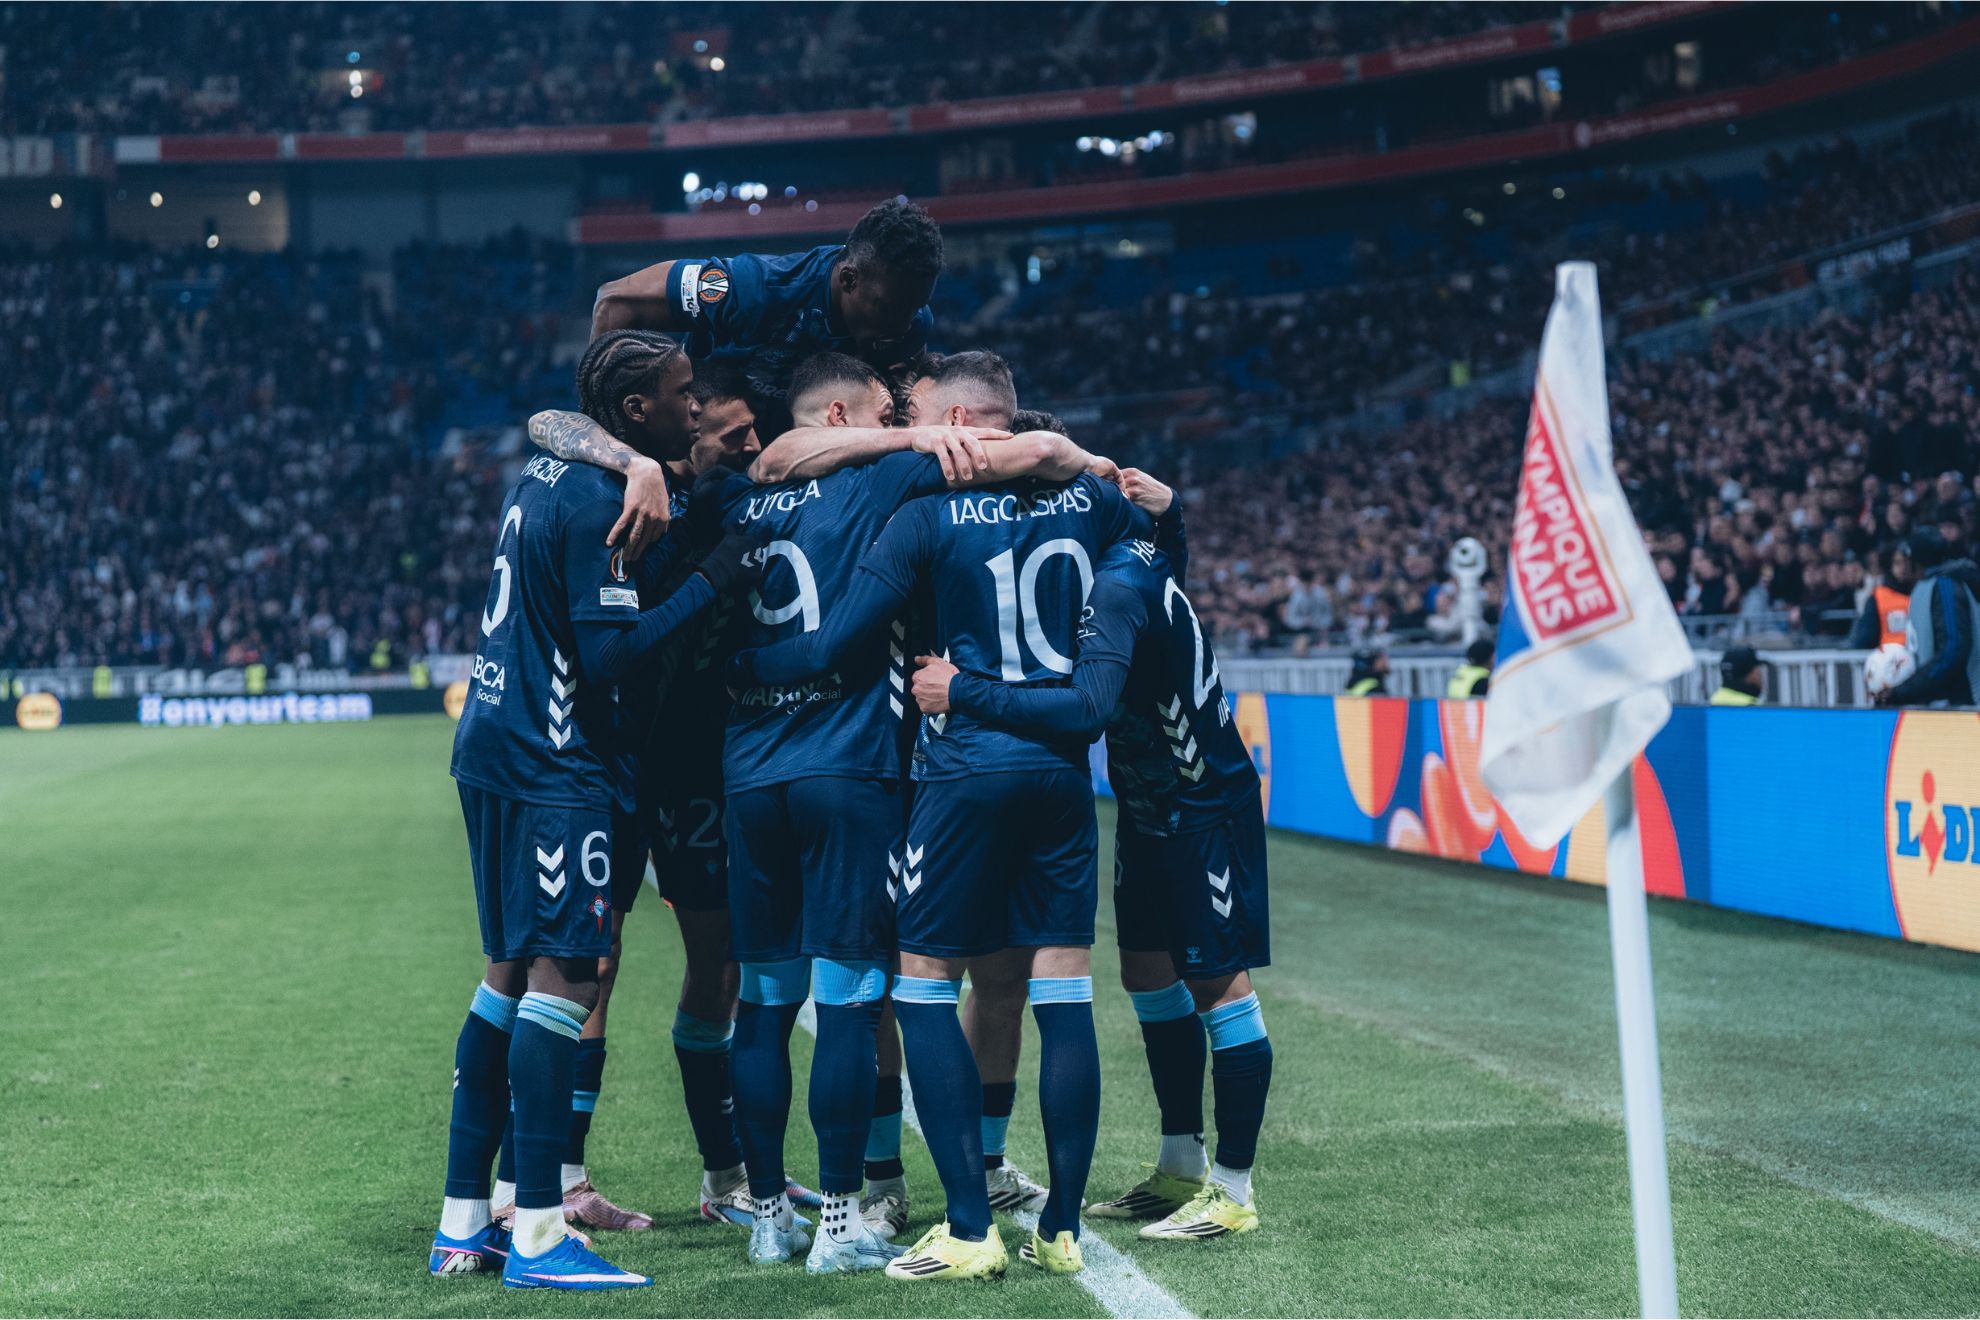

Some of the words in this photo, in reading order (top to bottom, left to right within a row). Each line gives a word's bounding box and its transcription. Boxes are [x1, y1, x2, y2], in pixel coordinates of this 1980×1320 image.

[1525, 426, 1609, 615] YMPIQUE
[747, 539, 821, 633] 9
[984, 537, 1095, 682] 10
[138, 692, 373, 727] #onyourteam
[581, 830, 611, 887] 6
[687, 797, 729, 848] 2
